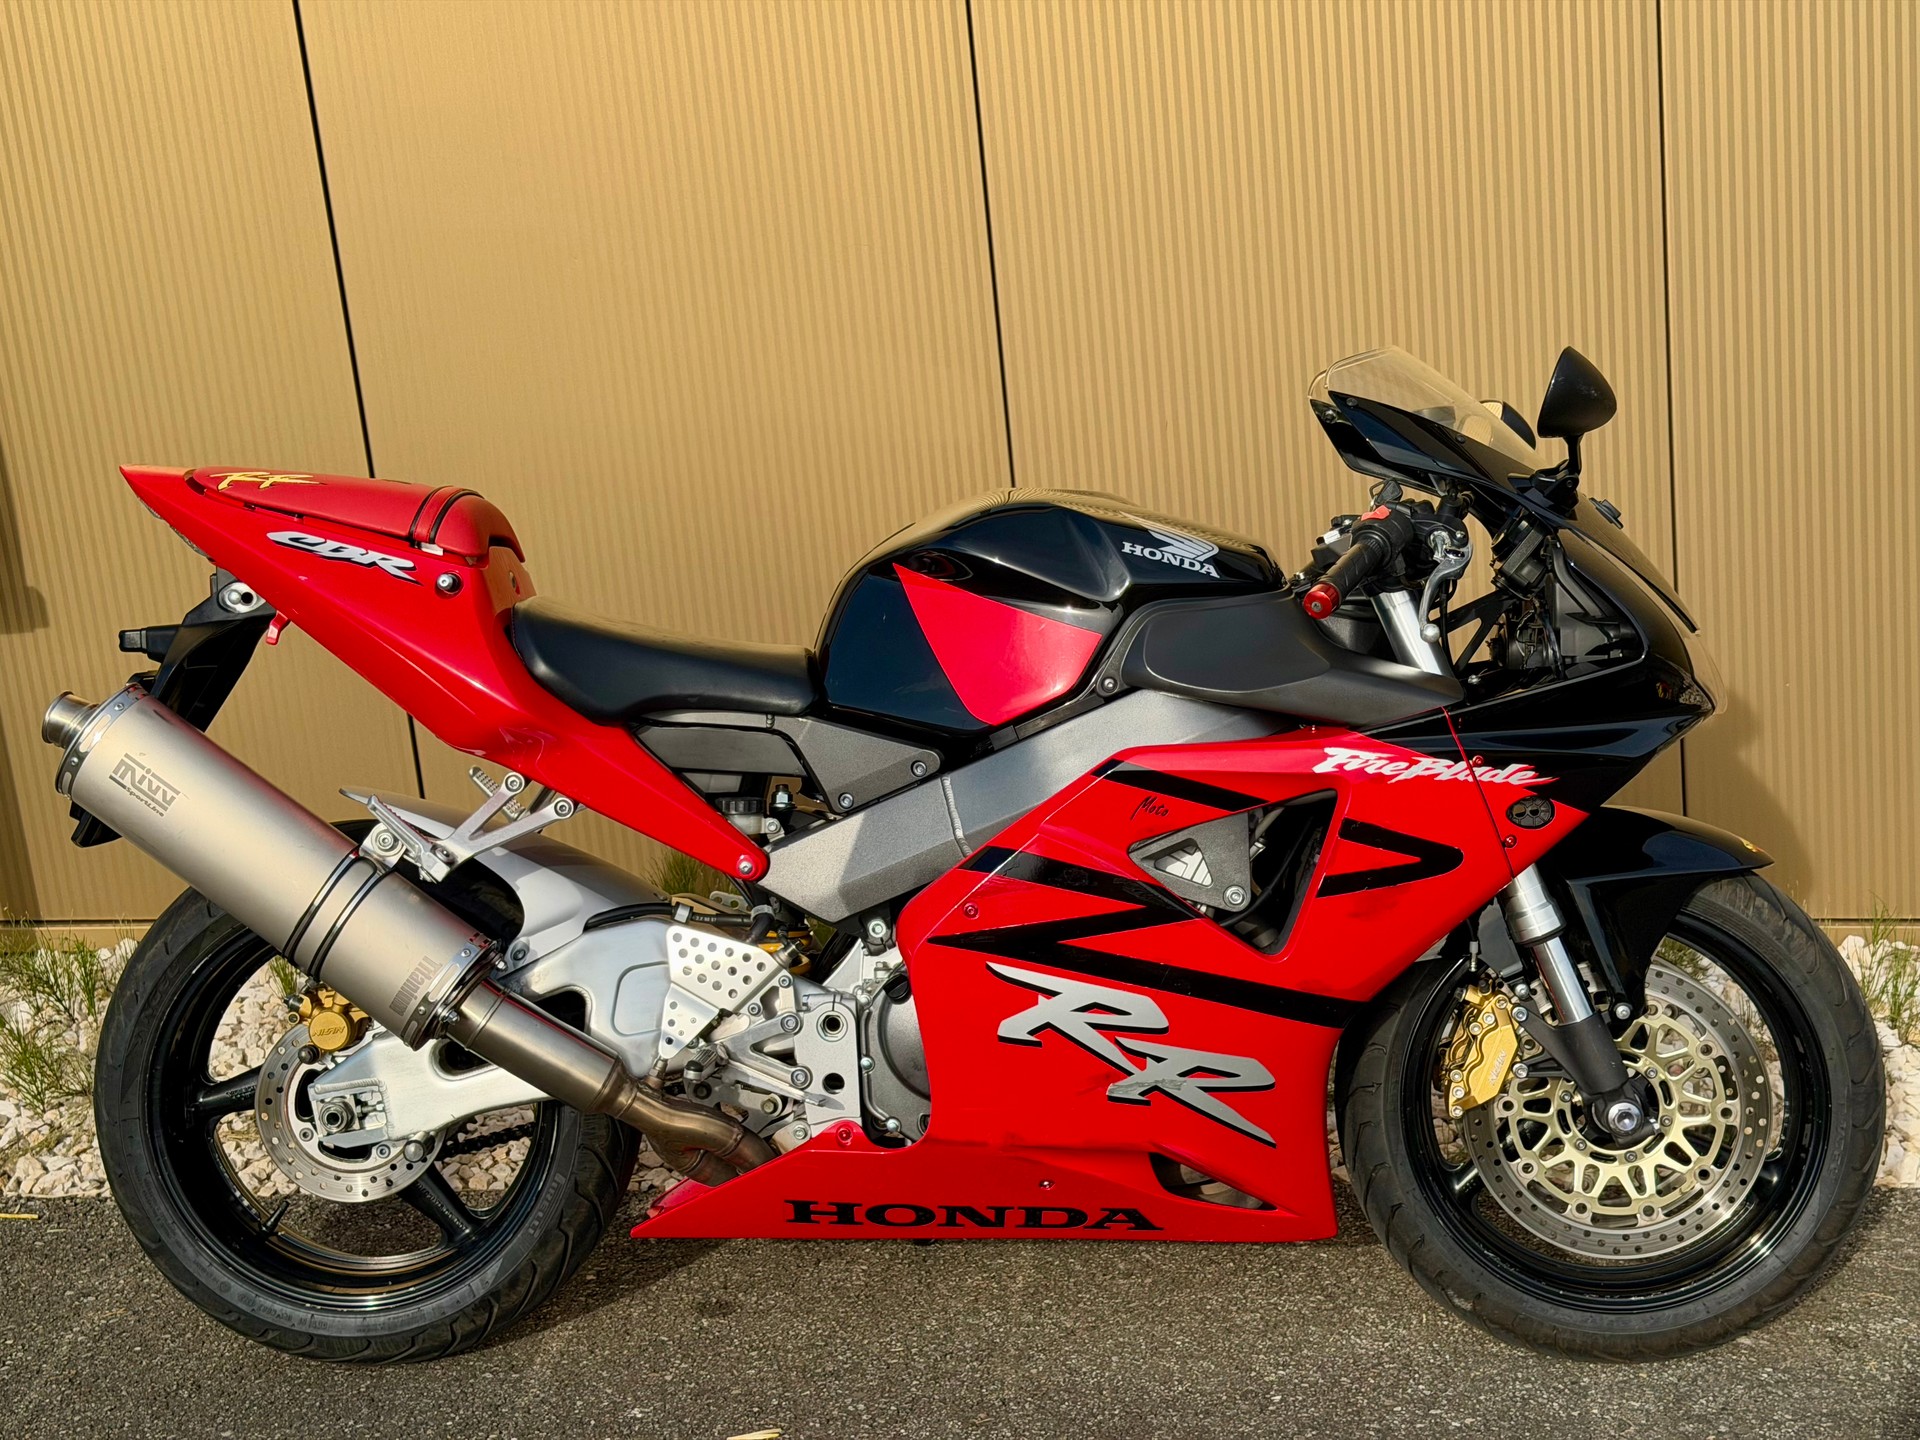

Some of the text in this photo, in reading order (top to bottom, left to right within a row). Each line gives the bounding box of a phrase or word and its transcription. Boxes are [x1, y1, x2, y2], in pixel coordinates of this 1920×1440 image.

[266, 531, 424, 586] CBR
[1121, 541, 1220, 578] HONDA
[1130, 795, 1169, 820] Moto
[389, 955, 443, 1017] Titanium
[986, 961, 1277, 1149] RR
[783, 1199, 1164, 1231] HONDA
